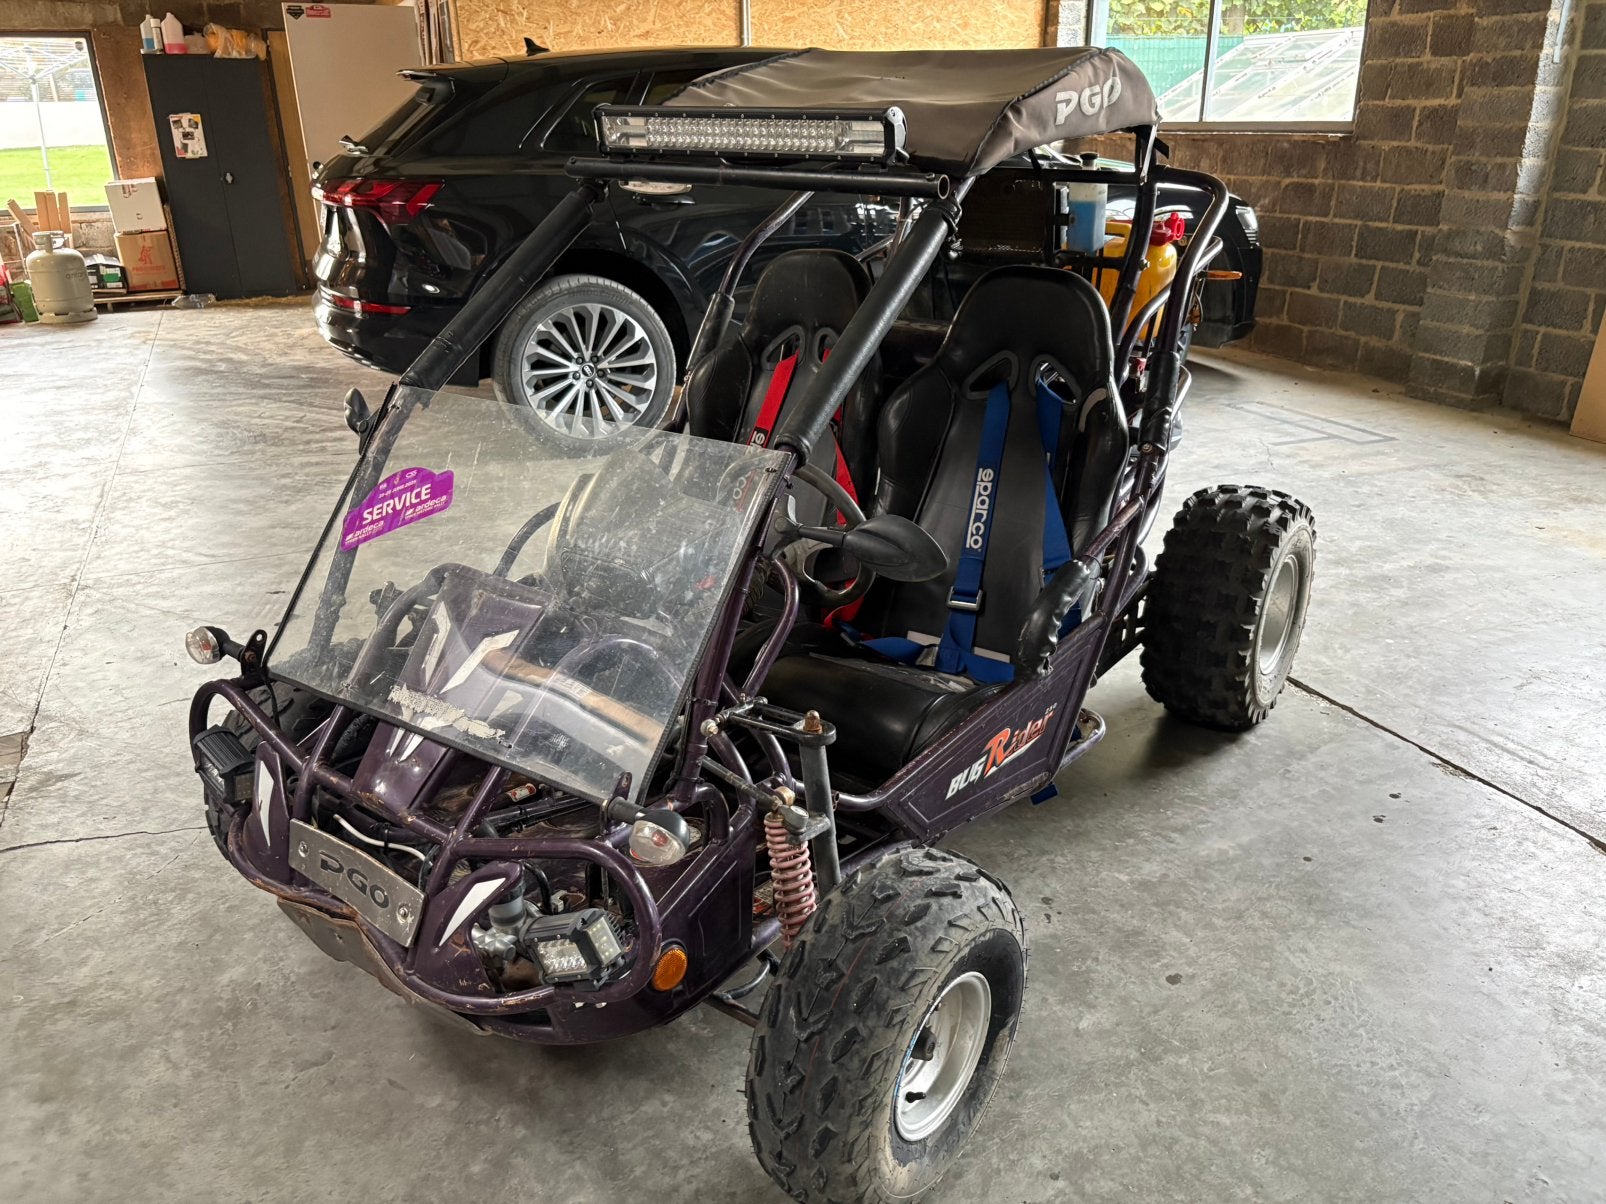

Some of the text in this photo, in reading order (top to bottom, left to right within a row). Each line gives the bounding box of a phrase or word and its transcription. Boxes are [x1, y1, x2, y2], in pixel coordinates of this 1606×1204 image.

[355, 520, 384, 536] ardeca
[362, 483, 431, 525] SERVICE
[416, 495, 447, 511] ardeca
[967, 468, 994, 549] sparco
[945, 712, 1054, 800] BUG Rider
[320, 851, 390, 909] PGO
